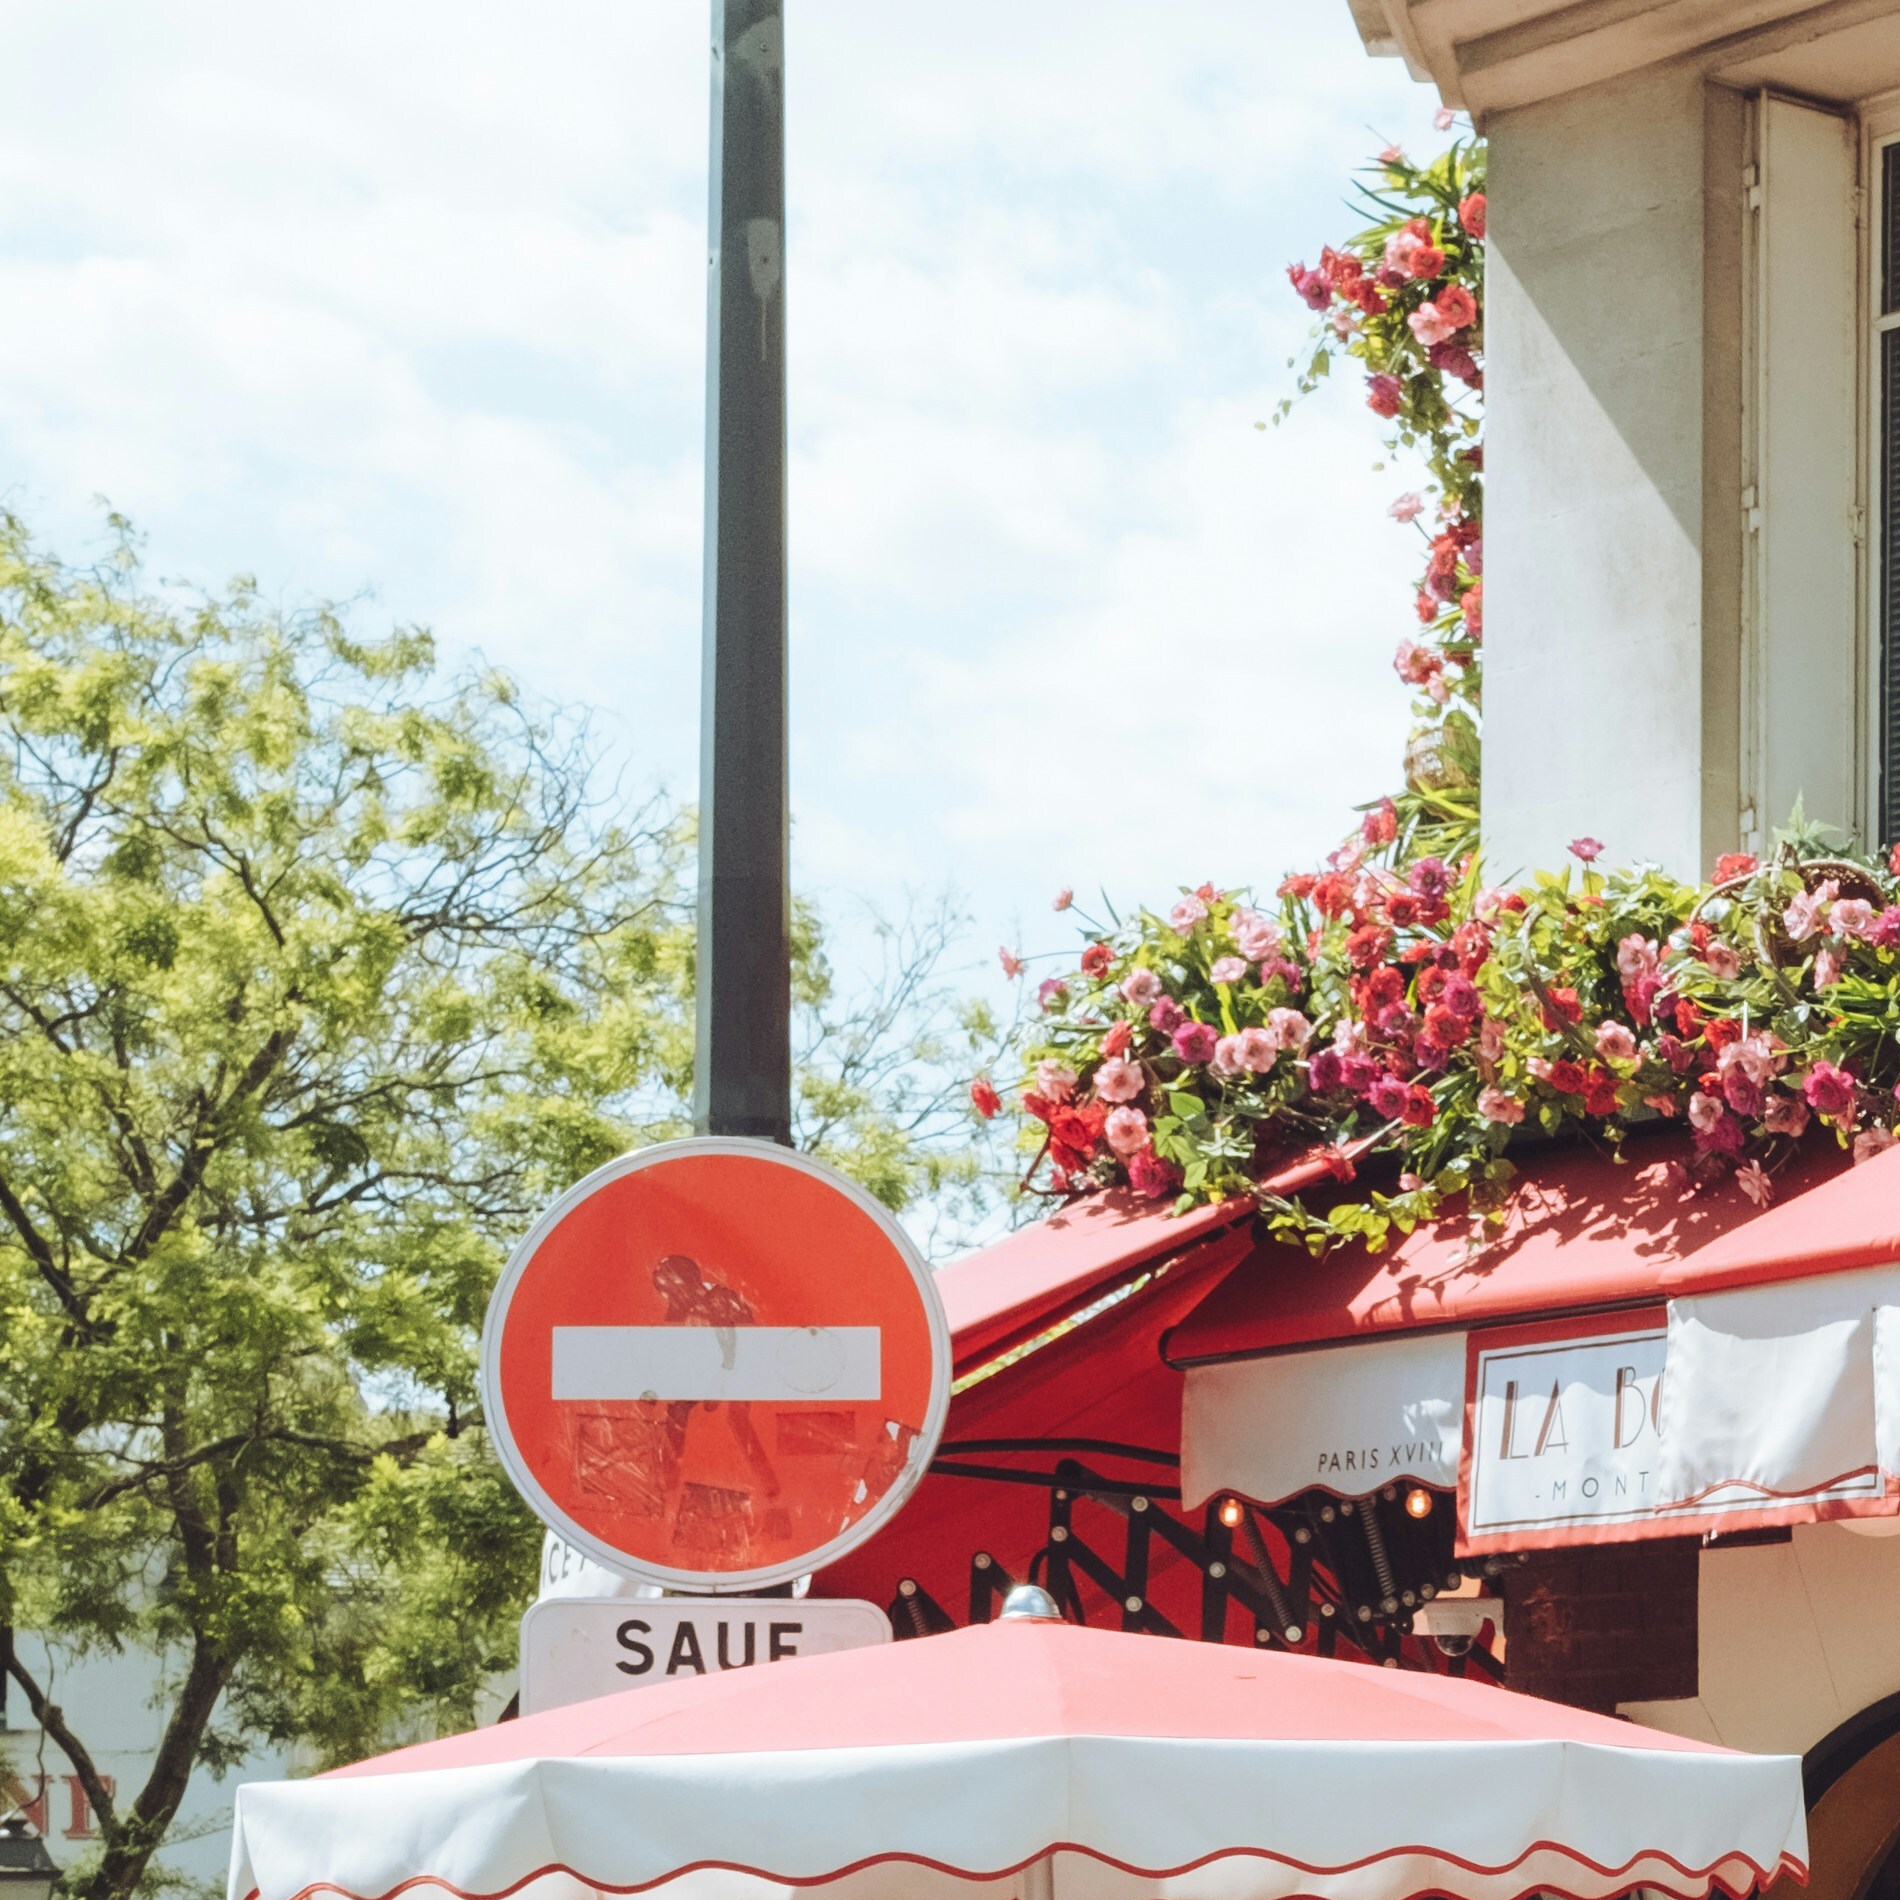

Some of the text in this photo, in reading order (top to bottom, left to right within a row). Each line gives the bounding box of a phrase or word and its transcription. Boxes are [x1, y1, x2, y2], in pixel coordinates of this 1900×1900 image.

[1498, 1377, 1571, 1462] LA
[1317, 1440, 1444, 1473] PARIS XVIII
